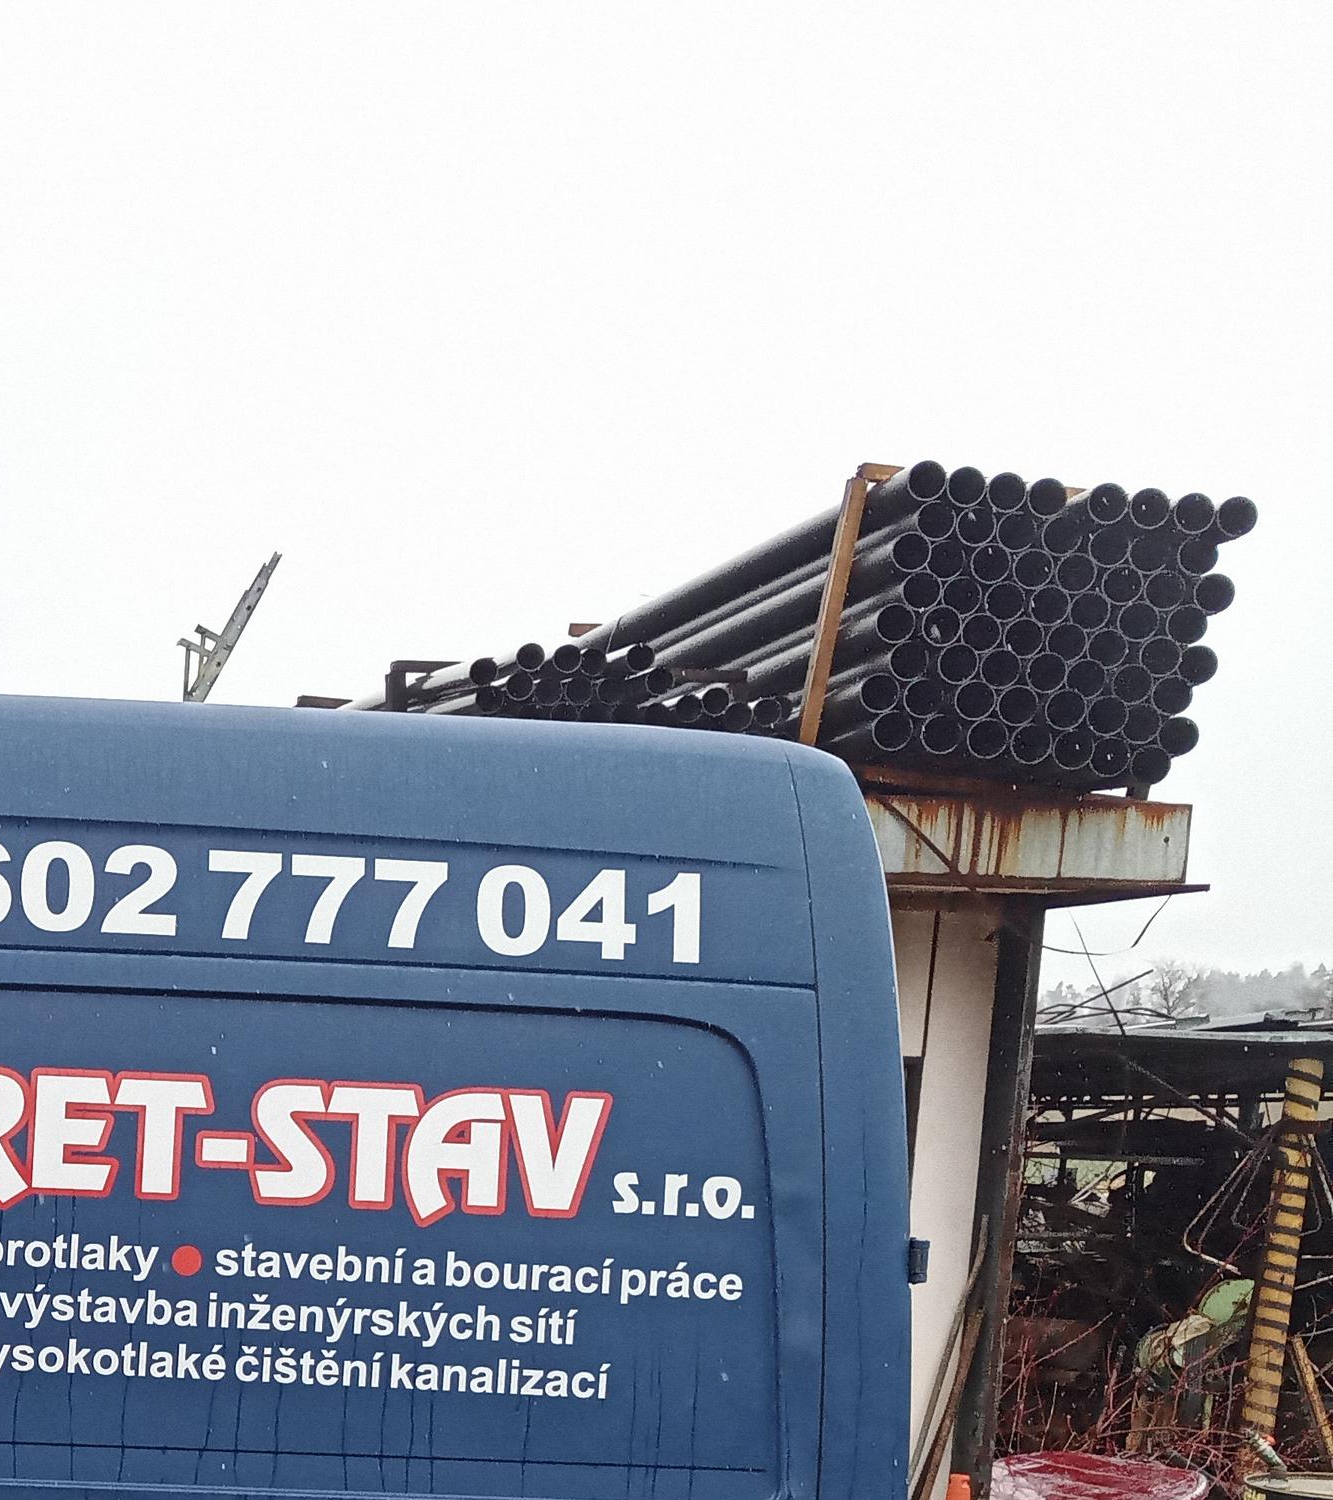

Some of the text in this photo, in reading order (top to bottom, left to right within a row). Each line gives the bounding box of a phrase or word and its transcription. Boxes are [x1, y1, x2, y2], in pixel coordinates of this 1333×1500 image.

[208, 849, 449, 949] 777
[476, 864, 701, 964] 041
[613, 1171, 755, 1220] s.r.o.
[214, 1242, 407, 1284] stavební
[411, 1258, 437, 1286] a
[445, 1251, 615, 1294] bourací
[620, 1261, 743, 1305] práce
[207, 1292, 501, 1348] inženýrských
[509, 1305, 579, 1345] sítí
[235, 1344, 385, 1388] čištění
[390, 1353, 611, 1399] kanalizací
